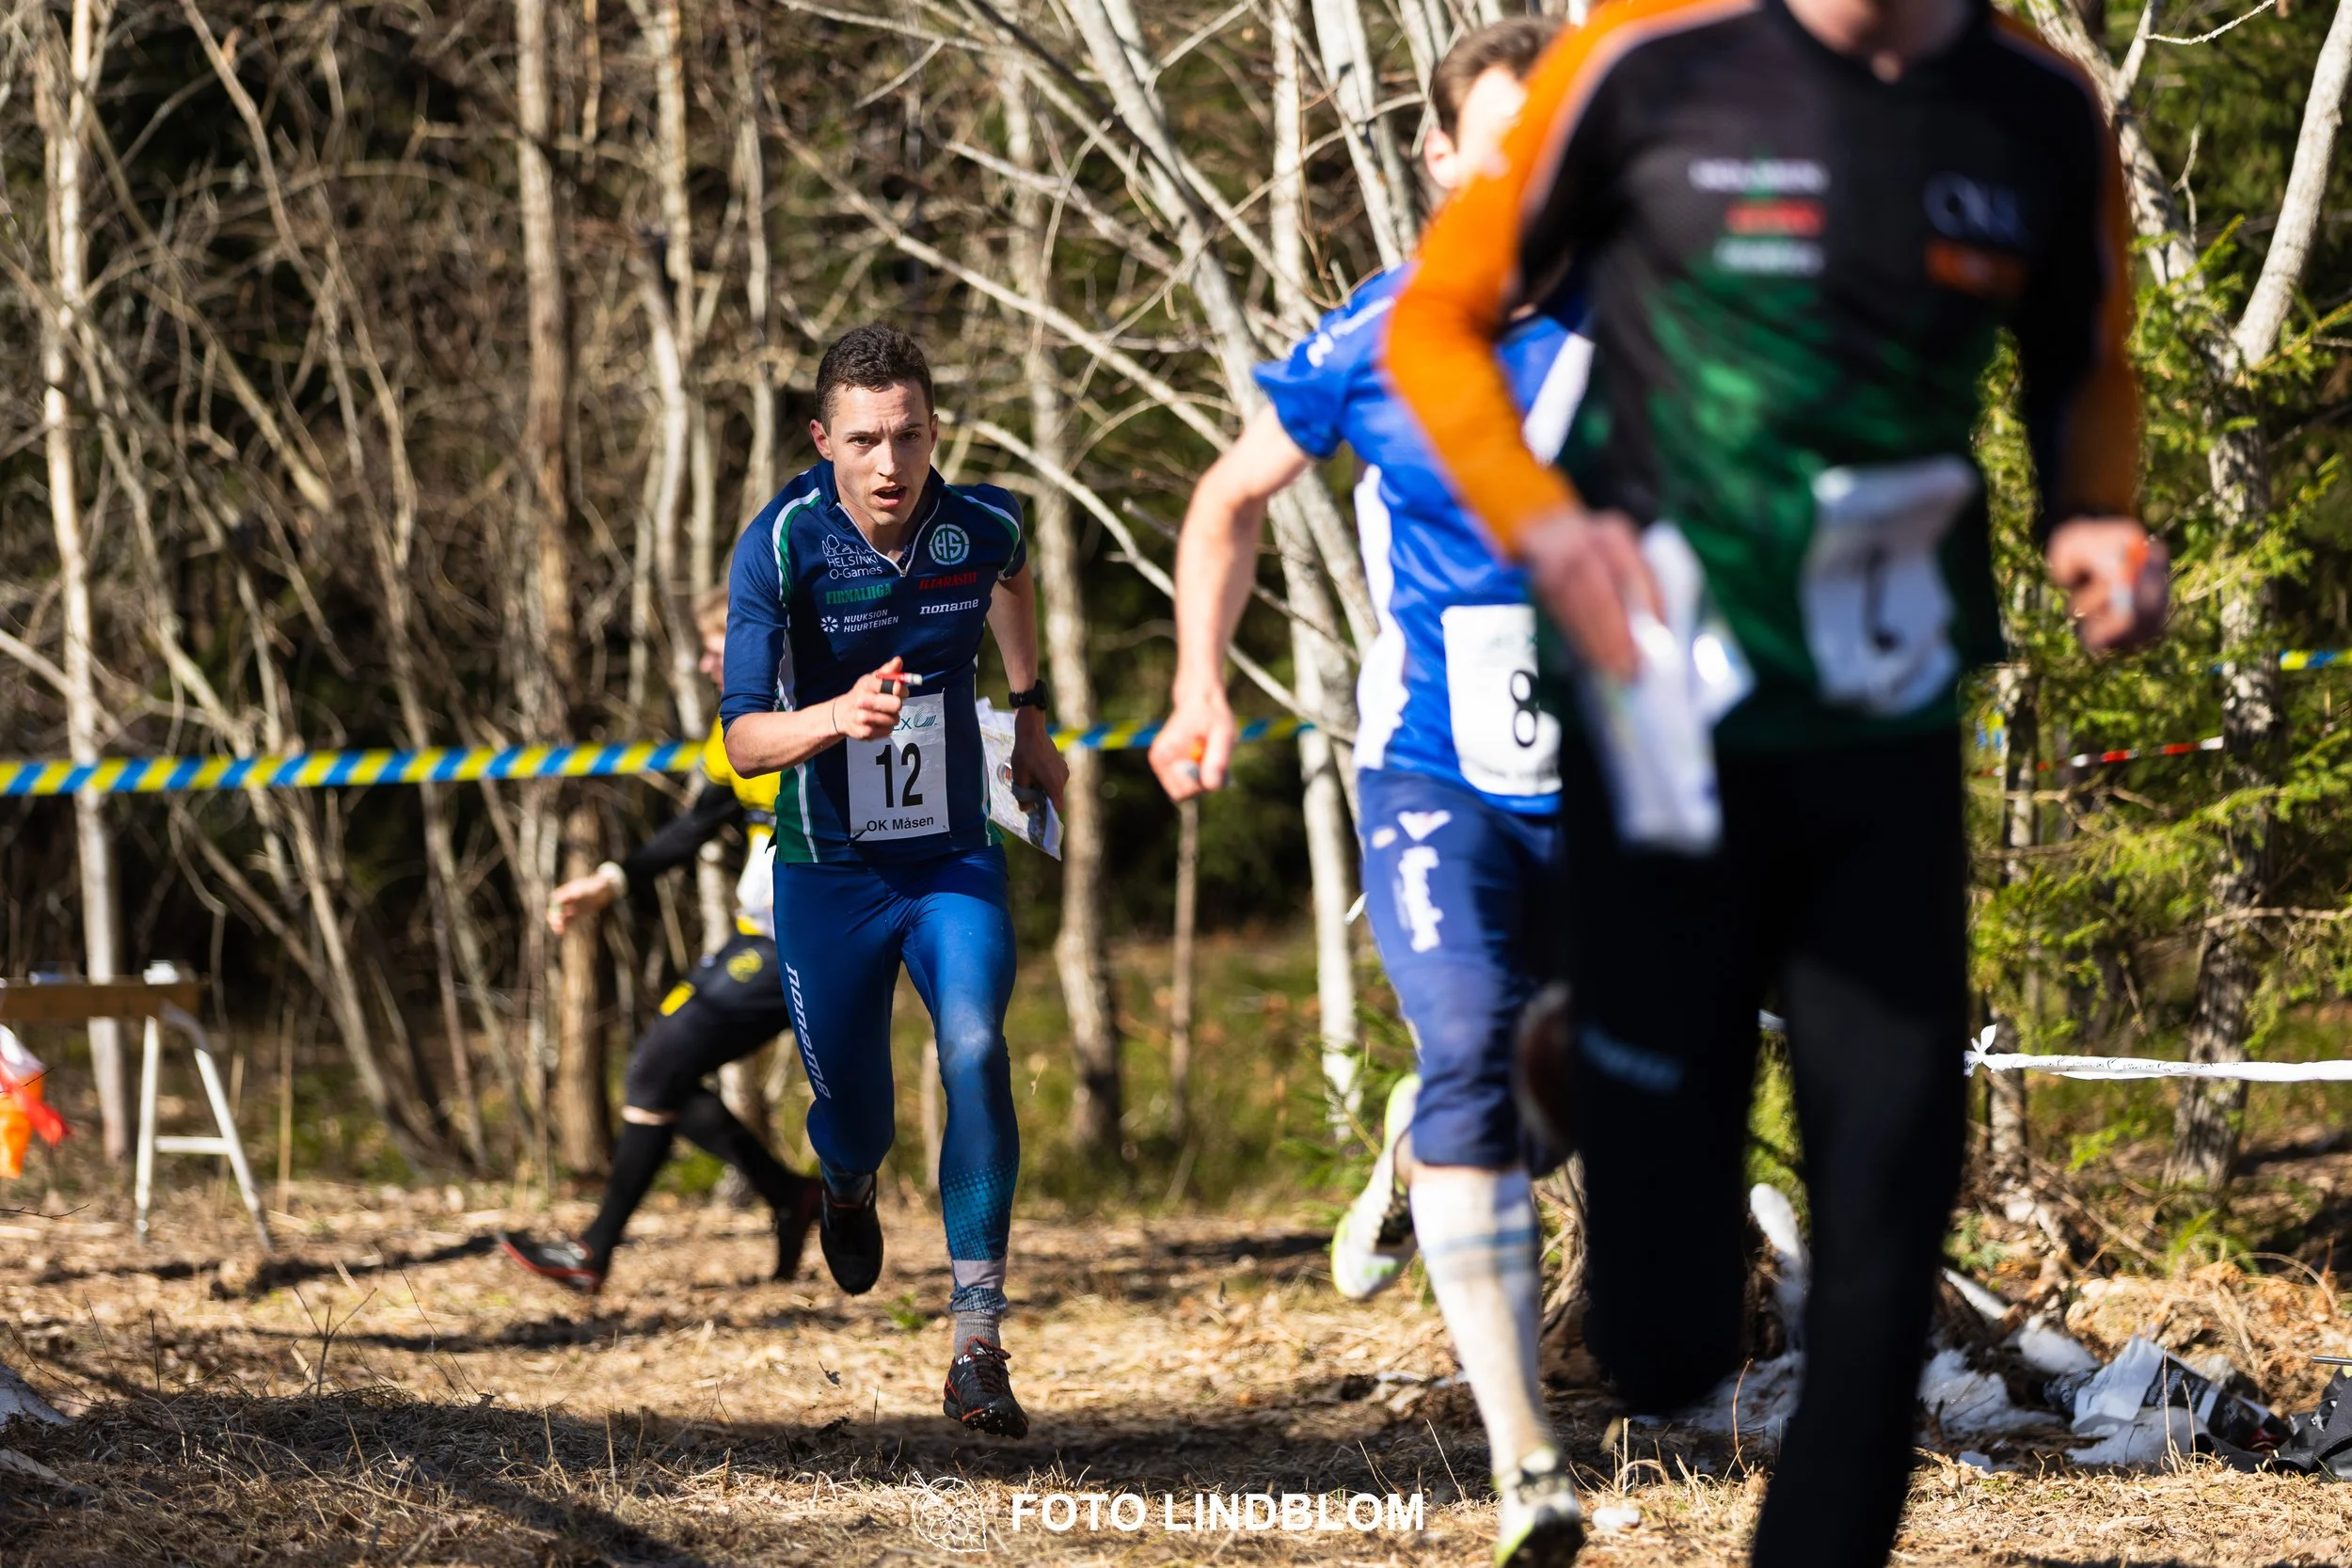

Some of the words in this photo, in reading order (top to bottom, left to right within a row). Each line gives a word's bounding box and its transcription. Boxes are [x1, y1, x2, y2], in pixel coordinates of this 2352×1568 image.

[826, 553, 879, 567] HELSINKI
[829, 565, 882, 579] O-Games
[826, 582, 892, 605] FIRMALIIGA
[919, 598, 979, 615] noname
[843, 609, 888, 624] NUUKSION
[843, 616, 899, 633] HUURTEINEN
[875, 742, 923, 808] 12
[866, 820, 888, 832] OK
[892, 816, 934, 831] Måsen
[785, 961, 832, 1099] noname
